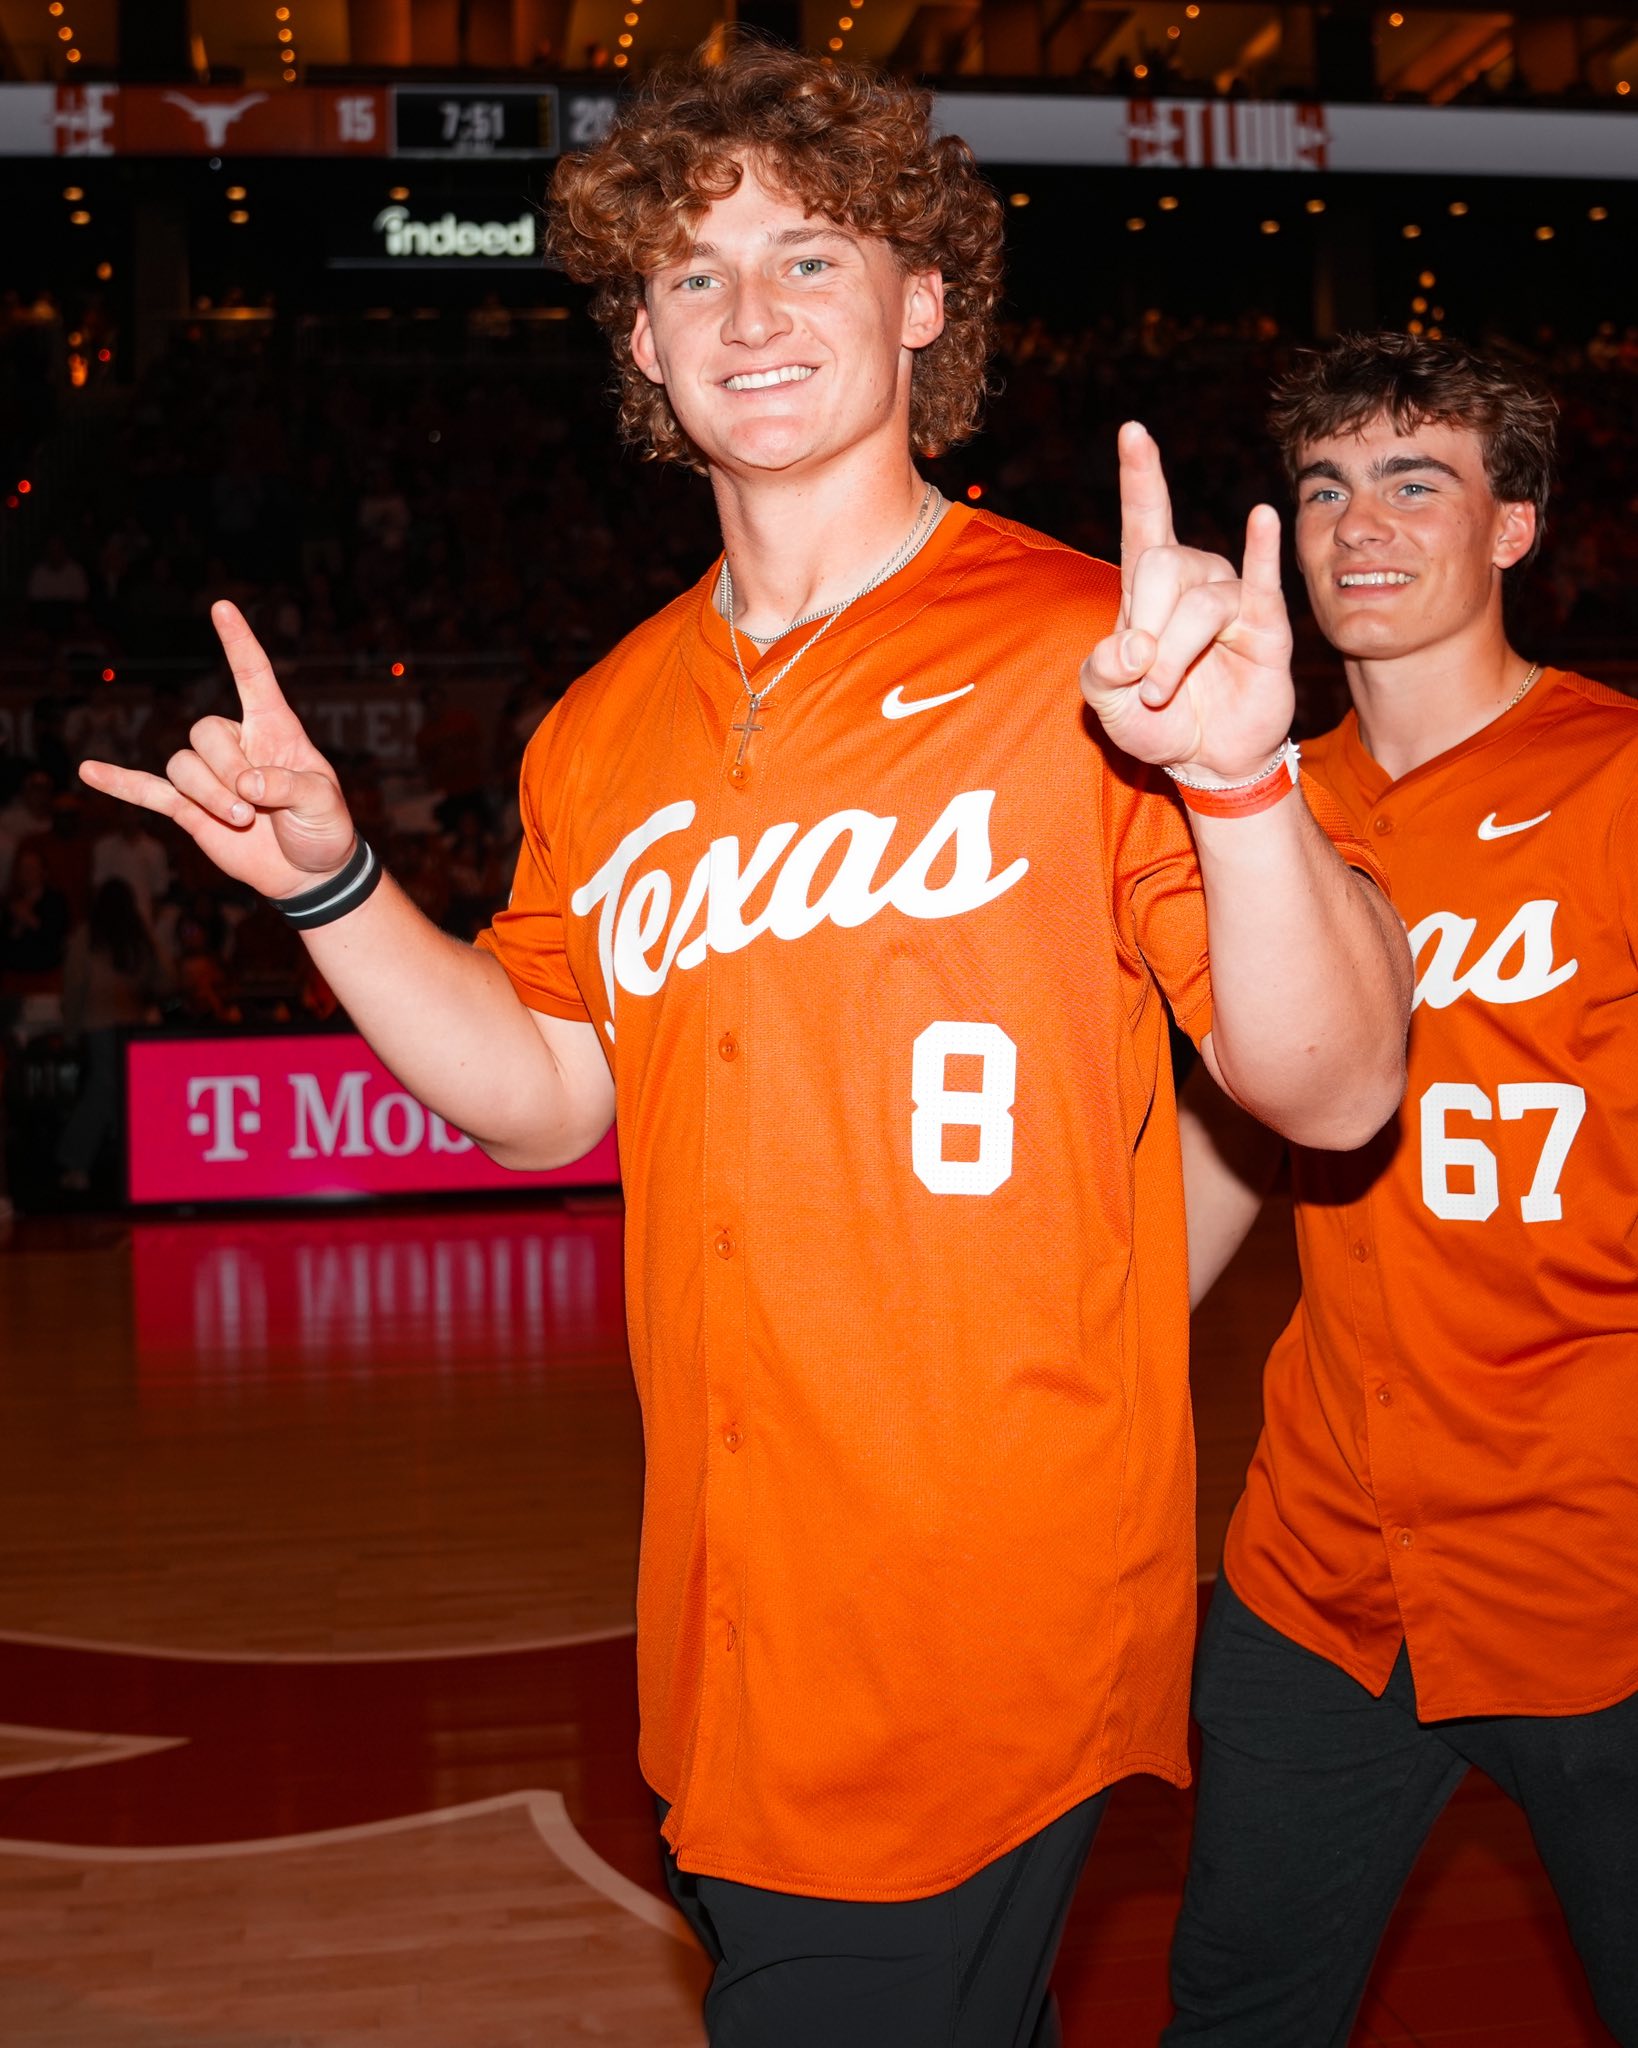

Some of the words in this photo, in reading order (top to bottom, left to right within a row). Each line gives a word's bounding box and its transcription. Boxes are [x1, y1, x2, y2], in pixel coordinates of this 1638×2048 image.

[335, 97, 375, 142] 15
[440, 102, 505, 141] 7:51
[373, 205, 535, 256] indeed
[571, 789, 1030, 1045] Texas
[1406, 898, 1578, 1013] as
[911, 1020, 1017, 1196] 8
[1420, 1082, 1586, 1223] 67
